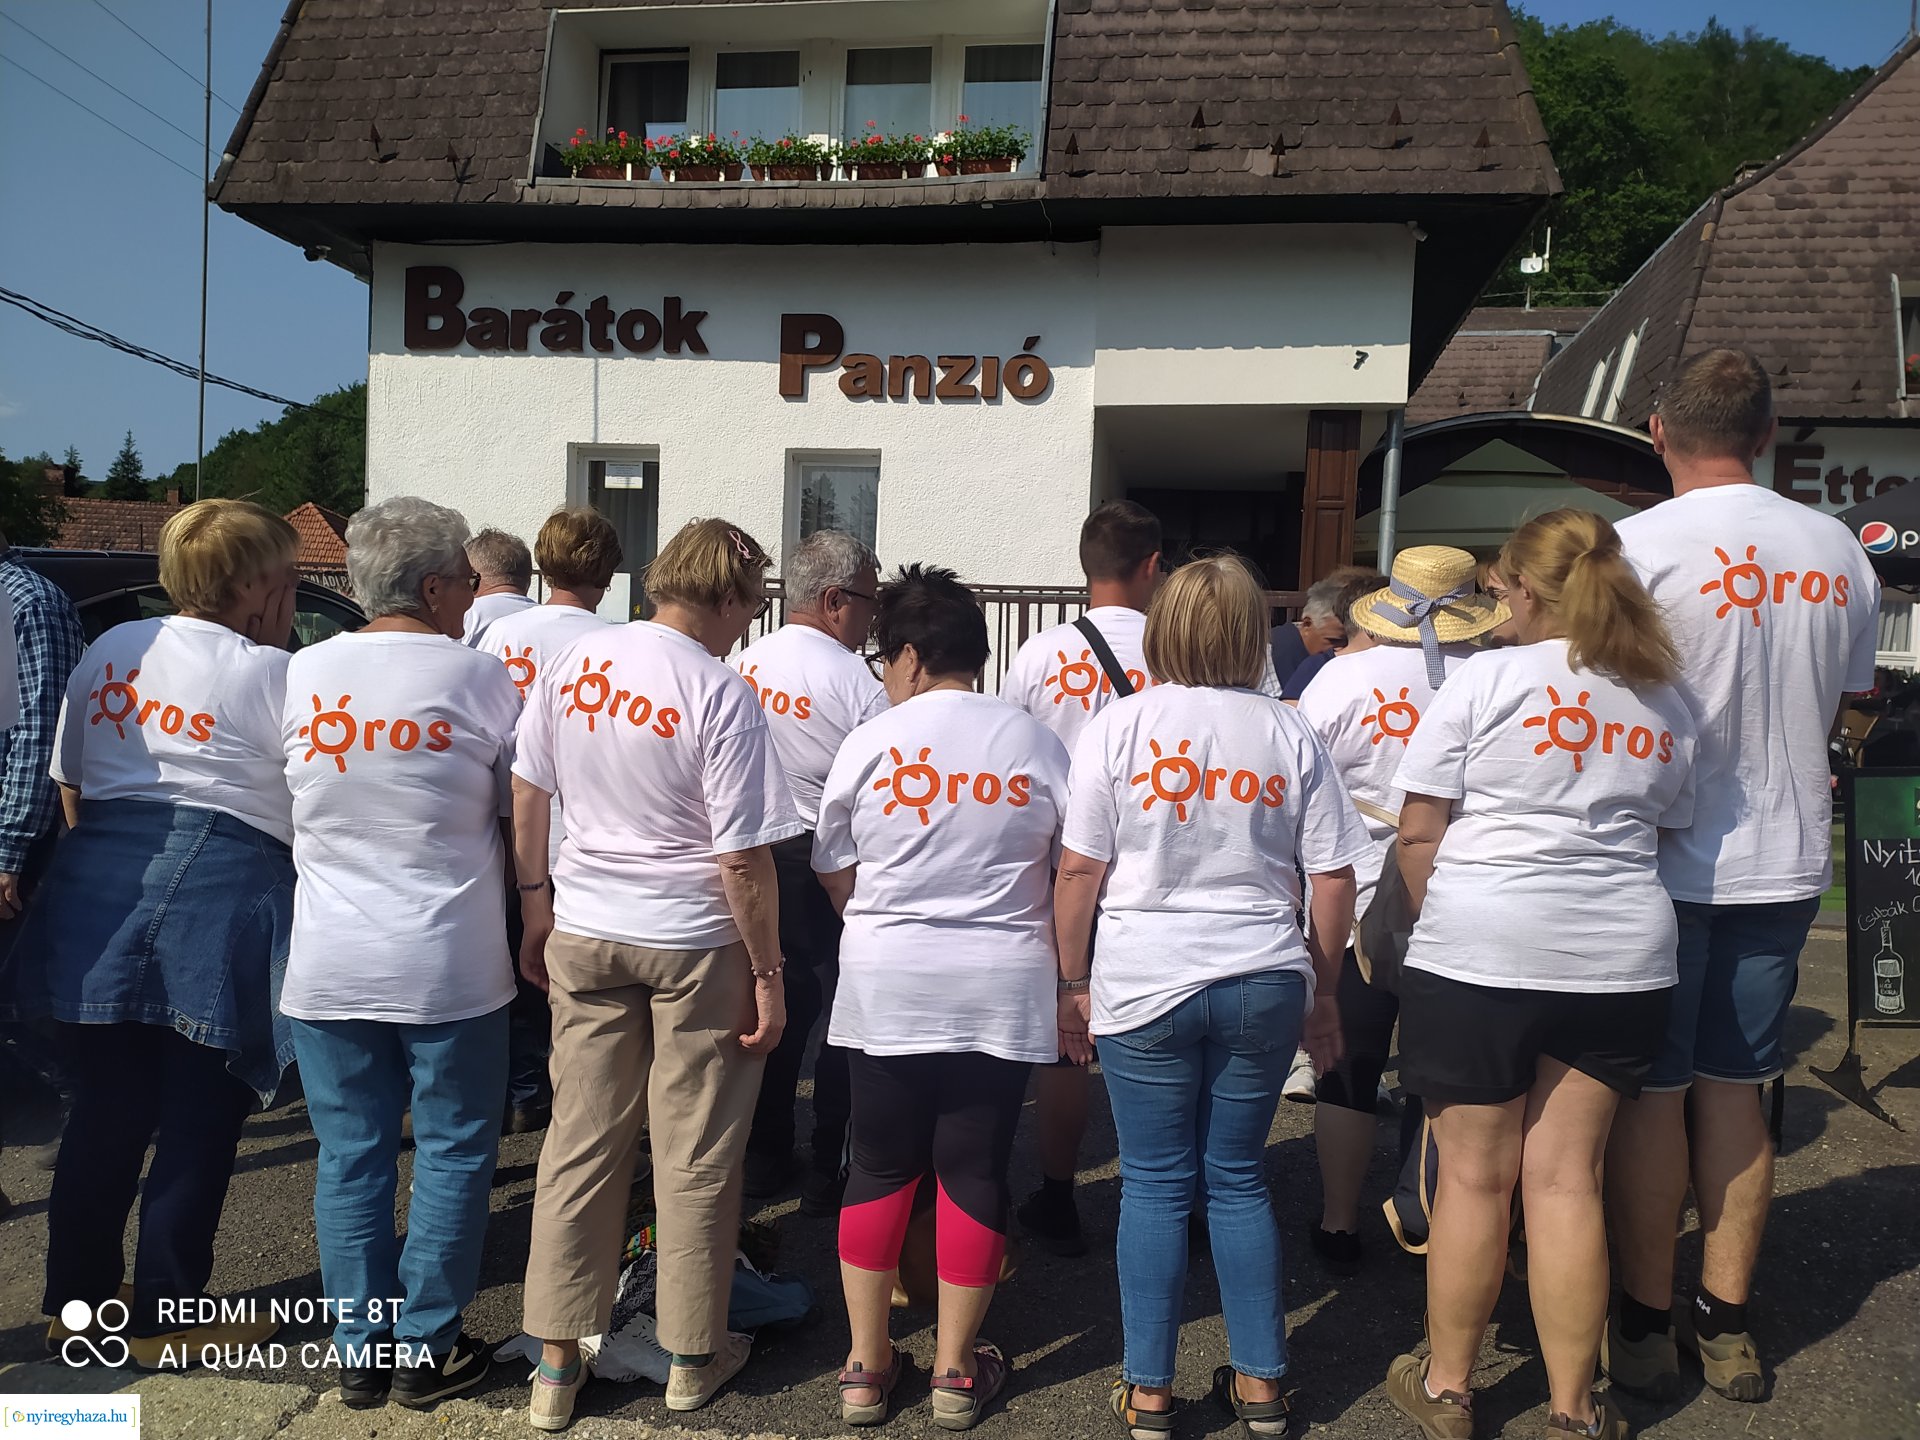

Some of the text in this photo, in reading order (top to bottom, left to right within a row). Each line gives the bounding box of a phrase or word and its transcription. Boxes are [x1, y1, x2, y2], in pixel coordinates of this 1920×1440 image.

[404, 265, 1051, 399] Barátok Panzió
[1352, 349, 1370, 371] 7
[1773, 428, 1920, 505] Étt
[1720, 559, 1851, 610] Oros
[98, 680, 217, 743] Oros
[307, 709, 455, 758] Oros
[572, 671, 683, 741] Oros
[1545, 704, 1676, 766] Oros
[889, 760, 1034, 810] Oros
[1149, 754, 1288, 810] Oros
[1863, 838, 1920, 868] Nyit
